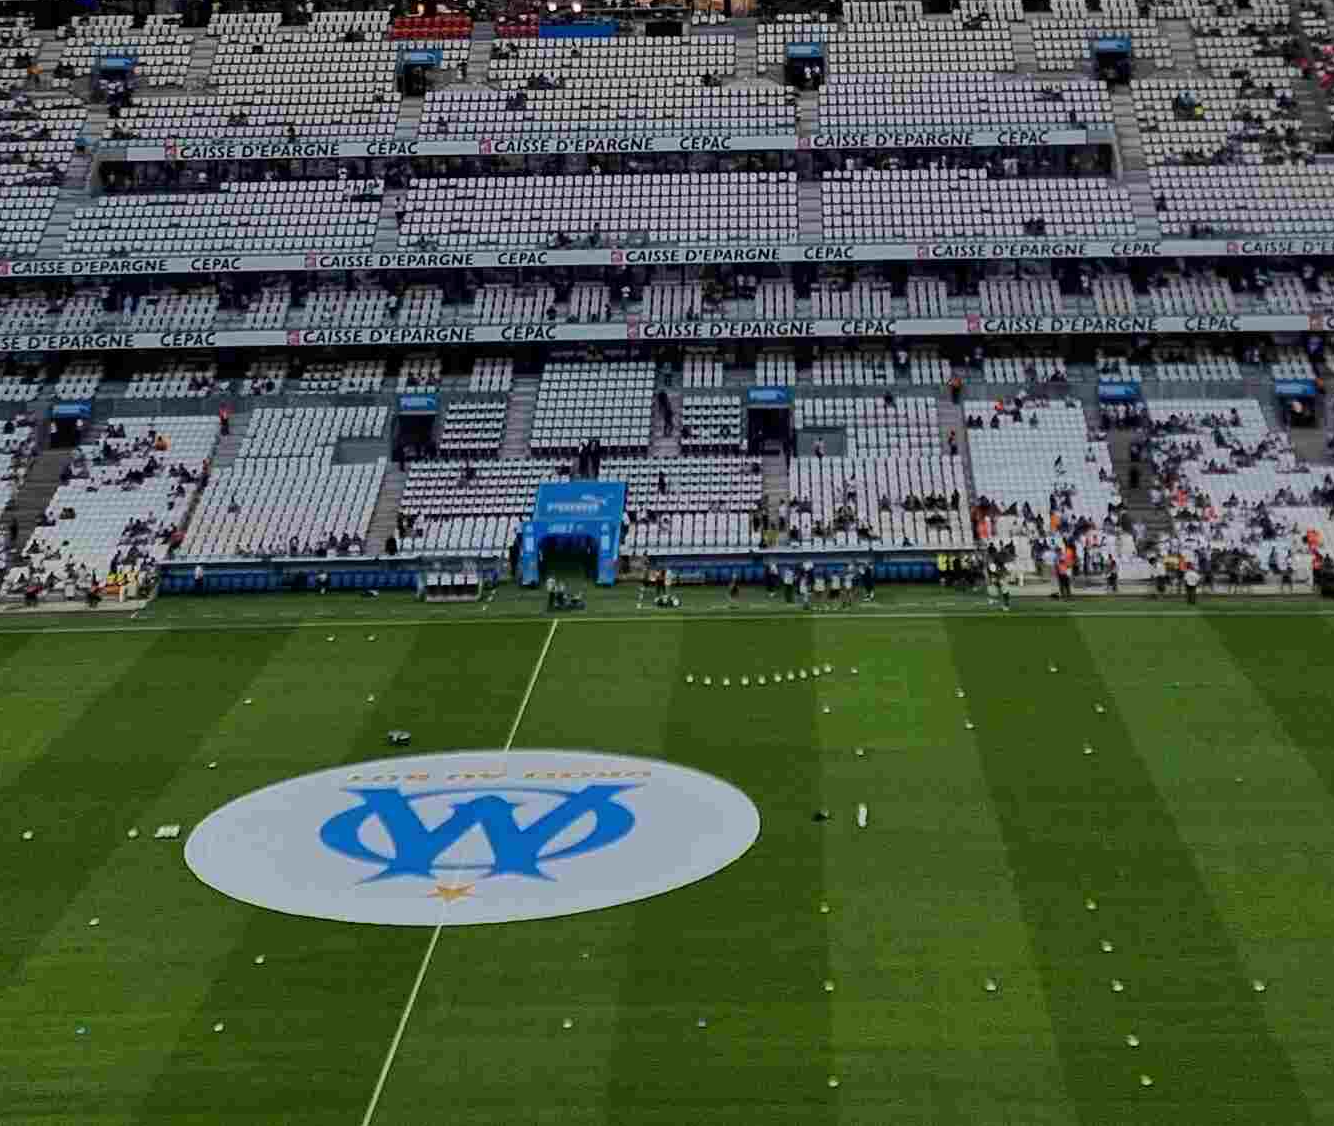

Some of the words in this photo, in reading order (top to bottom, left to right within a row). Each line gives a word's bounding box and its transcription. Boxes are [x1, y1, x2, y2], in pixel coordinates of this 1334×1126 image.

[494, 139, 551, 153] CAISSE
[679, 136, 732, 150] CEPAC
[813, 134, 870, 147] CAISSE
[997, 131, 1050, 145] CEPAC
[179, 145, 236, 159] CAISSE
[366, 141, 419, 155] CEPAC
[625, 249, 680, 263] CAISSE
[803, 246, 854, 259] CEPAC
[932, 245, 987, 258] CAISSE
[1111, 242, 1162, 256] CEPAC
[11, 261, 66, 275] CAISSE
[190, 258, 242, 271] CEPAC
[319, 255, 373, 269] CAISSE
[497, 252, 548, 265] CEPAC
[642, 324, 704, 338] CAISSE
[841, 320, 897, 334] CEPAC
[983, 318, 1044, 333] CAISSE
[1183, 316, 1241, 330] CEPAC
[160, 332, 216, 346] CEPAC
[302, 330, 364, 344] CAISSE
[500, 326, 557, 340] CEPAC
